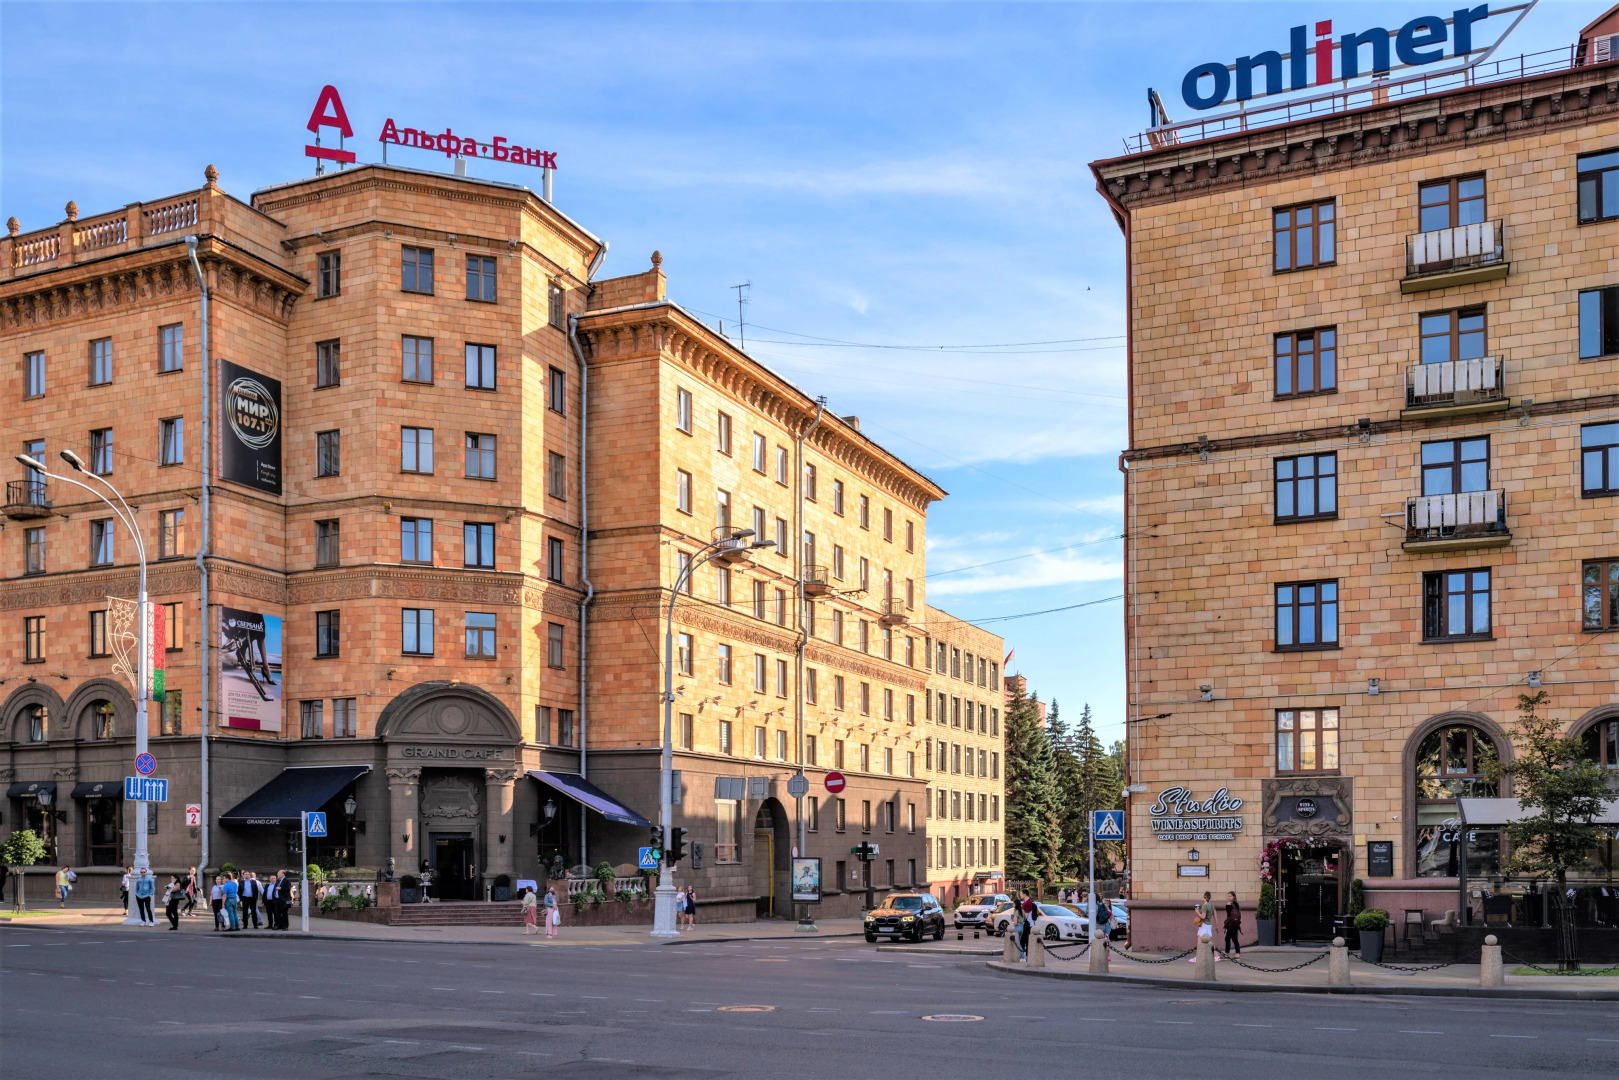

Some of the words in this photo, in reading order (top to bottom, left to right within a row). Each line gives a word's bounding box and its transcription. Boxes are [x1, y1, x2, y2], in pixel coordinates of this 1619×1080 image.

[1181, 2, 1489, 110] onliner
[237, 396, 270, 418] МИР
[237, 412, 265, 432] 107.1
[236, 620, 264, 632] СБЕРБАНК
[402, 747, 459, 758] GRAND
[462, 749, 503, 759] CAFE
[1150, 786, 1243, 815] Studio
[190, 813, 197, 824] 2
